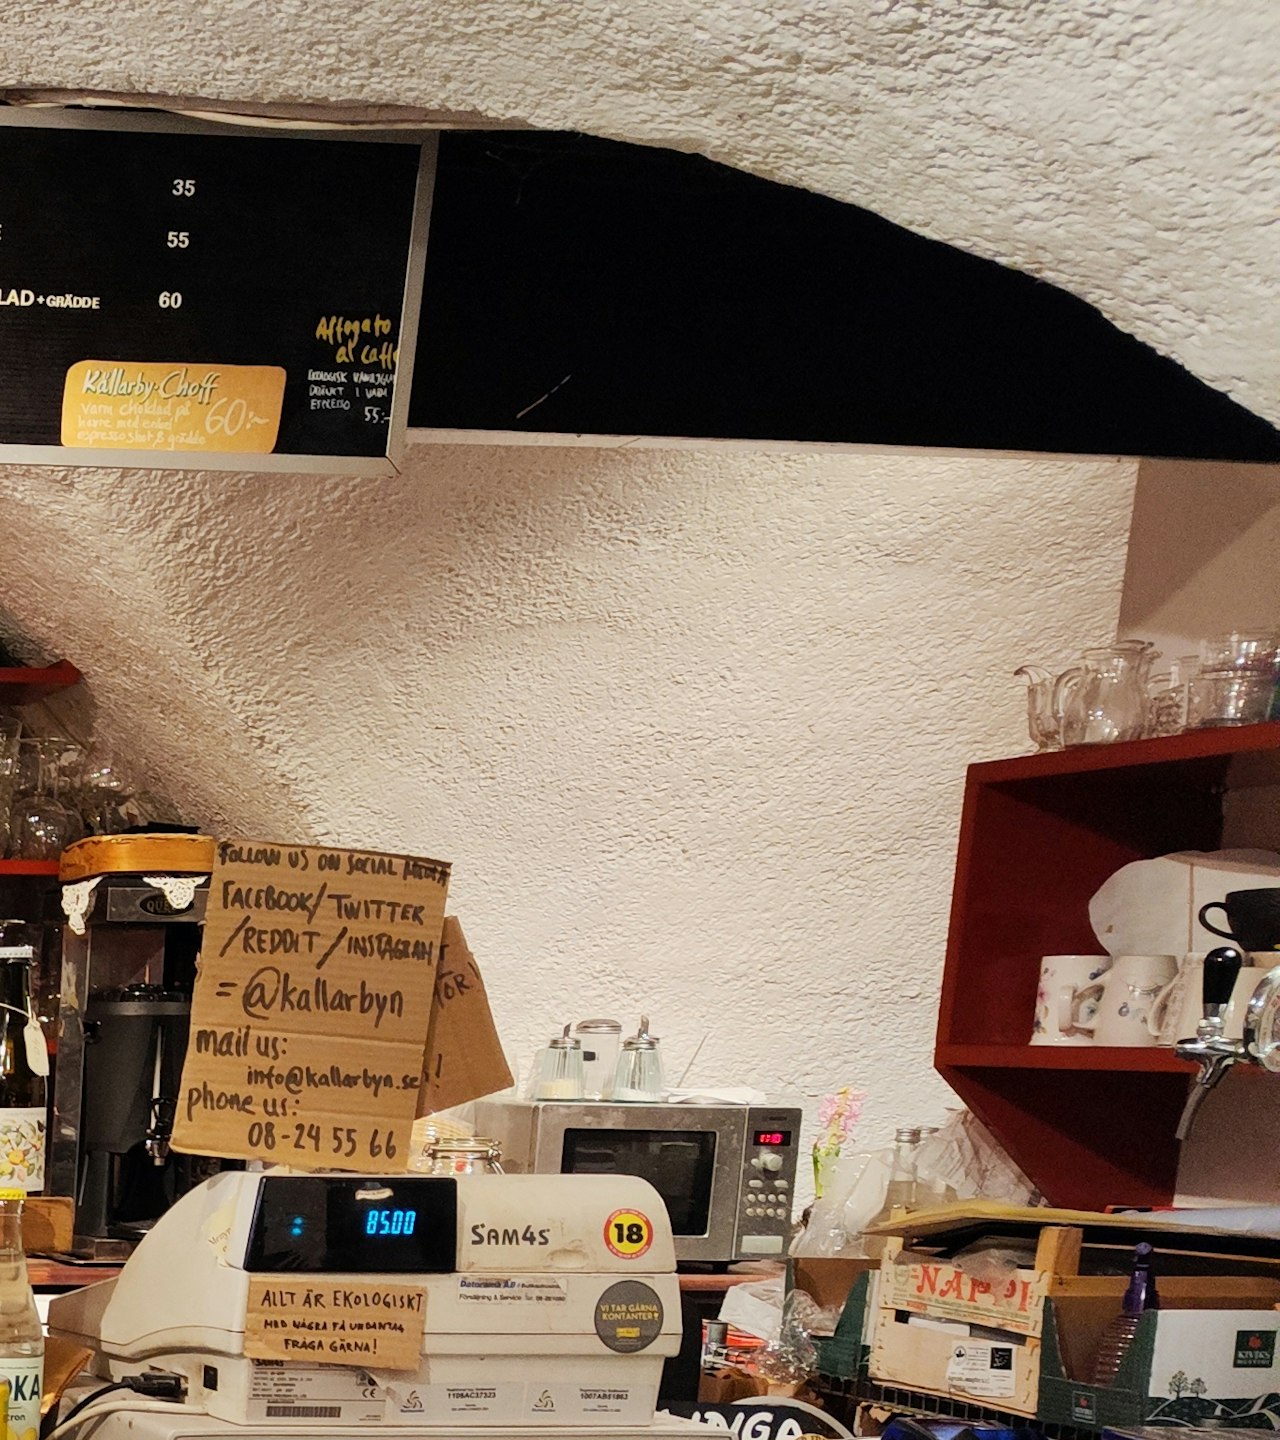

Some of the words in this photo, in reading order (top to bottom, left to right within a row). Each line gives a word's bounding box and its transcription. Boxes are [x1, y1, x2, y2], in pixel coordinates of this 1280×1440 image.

[172, 179, 195, 197] 35
[167, 232, 190, 248] 55
[159, 292, 182, 309] 60
[336, 338, 354, 363] al
[218, 841, 281, 868] FOLLOW
[288, 850, 309, 871] US
[318, 853, 341, 871] ON
[346, 852, 398, 876] SOCIAL
[242, 966, 404, 1028] @kallarbyn
[196, 1026, 252, 1057] mail
[256, 1036, 287, 1060] us:
[187, 1082, 256, 1121] phone
[264, 1095, 299, 1117] us:
[248, 1122, 321, 1152] 08-24
[332, 1127, 357, 1157] 55
[370, 1130, 396, 1159] 66
[613, 1222, 645, 1244] 18
[261, 1290, 296, 1309] ALLT
[302, 1289, 325, 1308] ÄR
[333, 1290, 425, 1312] EKOLOGISKT
[628, 1304, 658, 1313] GÄRNA
[284, 1337, 325, 1353] FRÅGA
